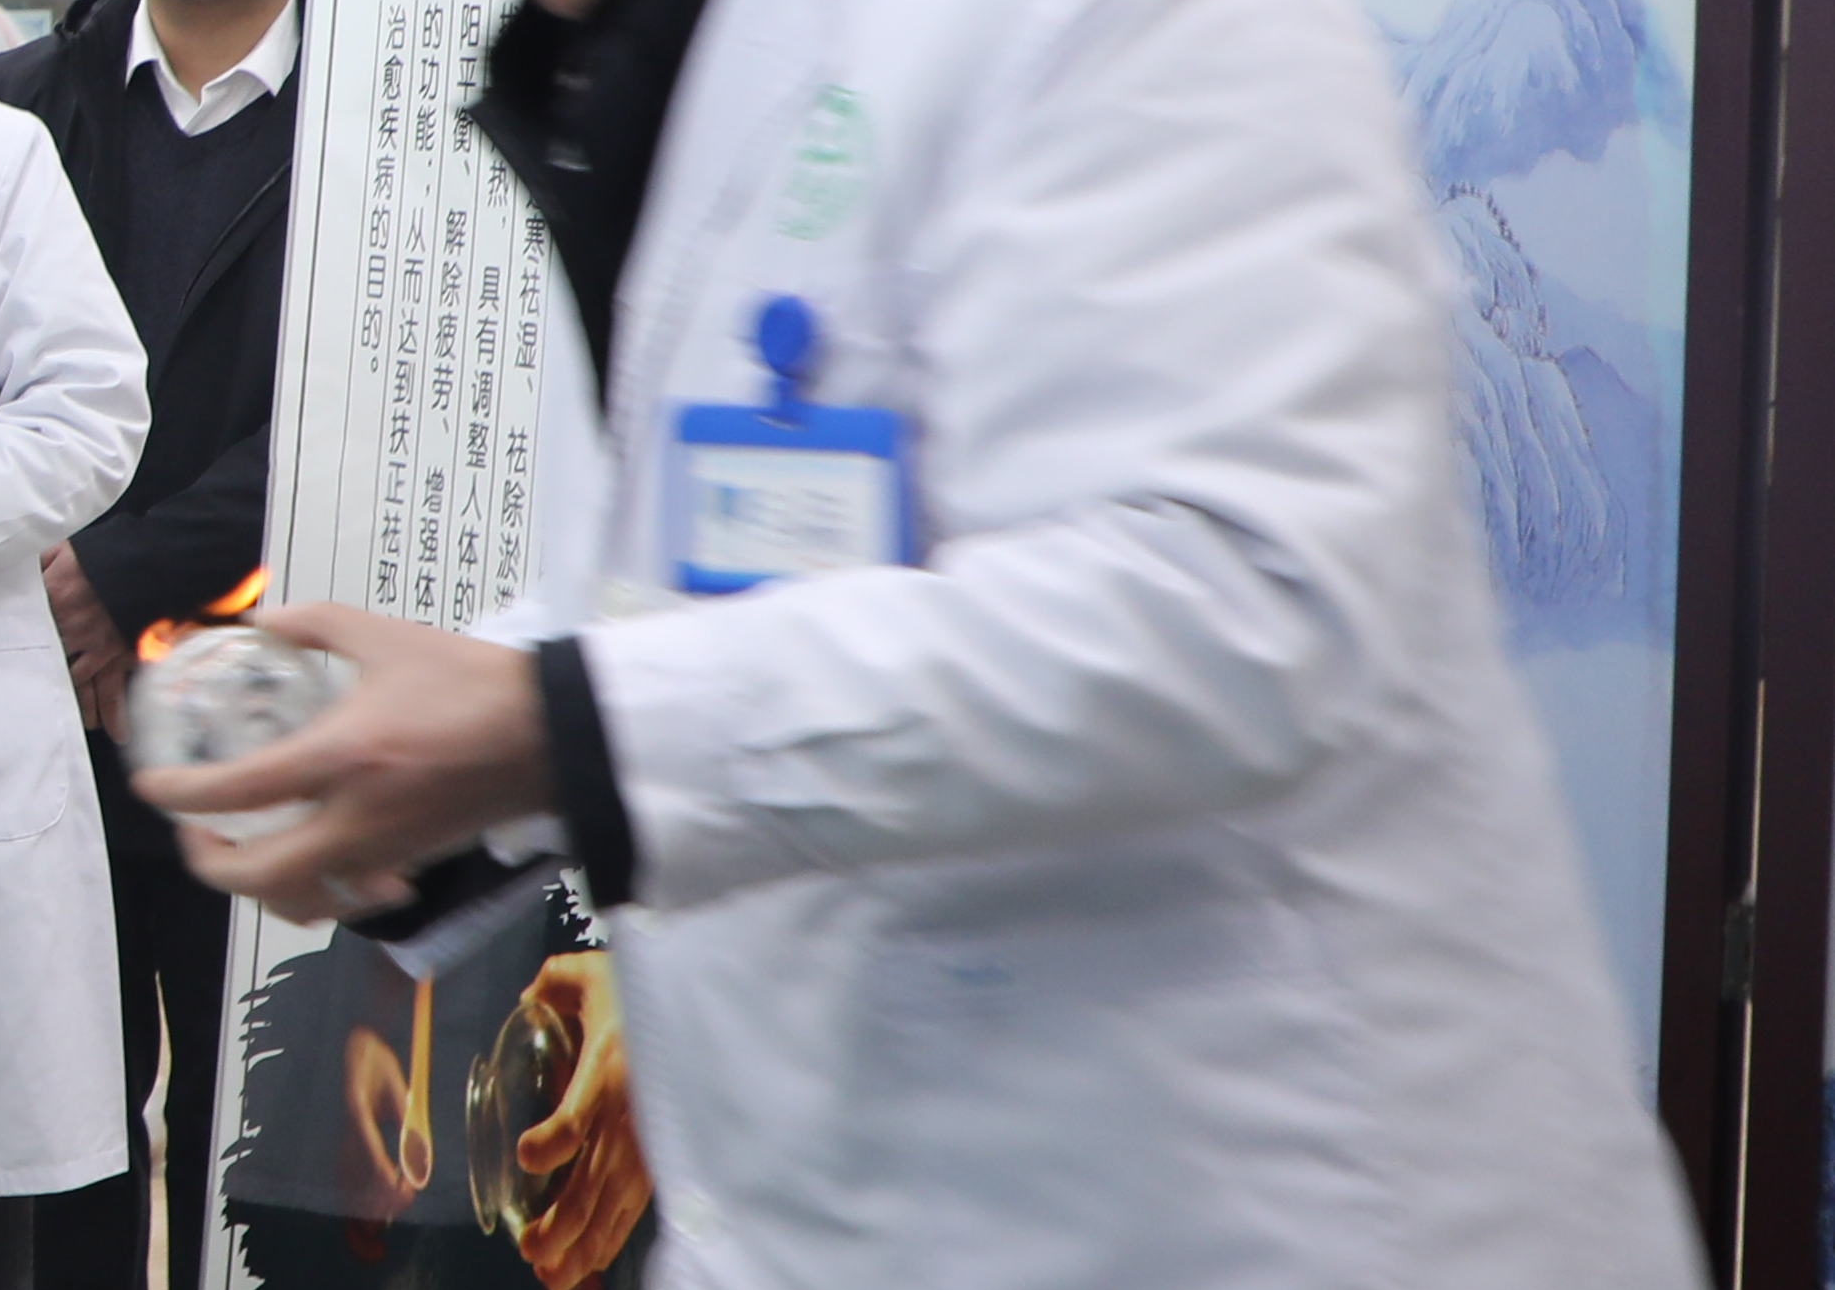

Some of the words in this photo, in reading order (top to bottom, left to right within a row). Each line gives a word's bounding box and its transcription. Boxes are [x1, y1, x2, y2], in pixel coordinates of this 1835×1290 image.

[361, 4, 407, 375] 治愈疾病的目的。
[375, 2, 444, 618] 的功能；从而达到扶正祛邪
[414, 3, 482, 625] 阳平衡、解除疲劳、增强体
